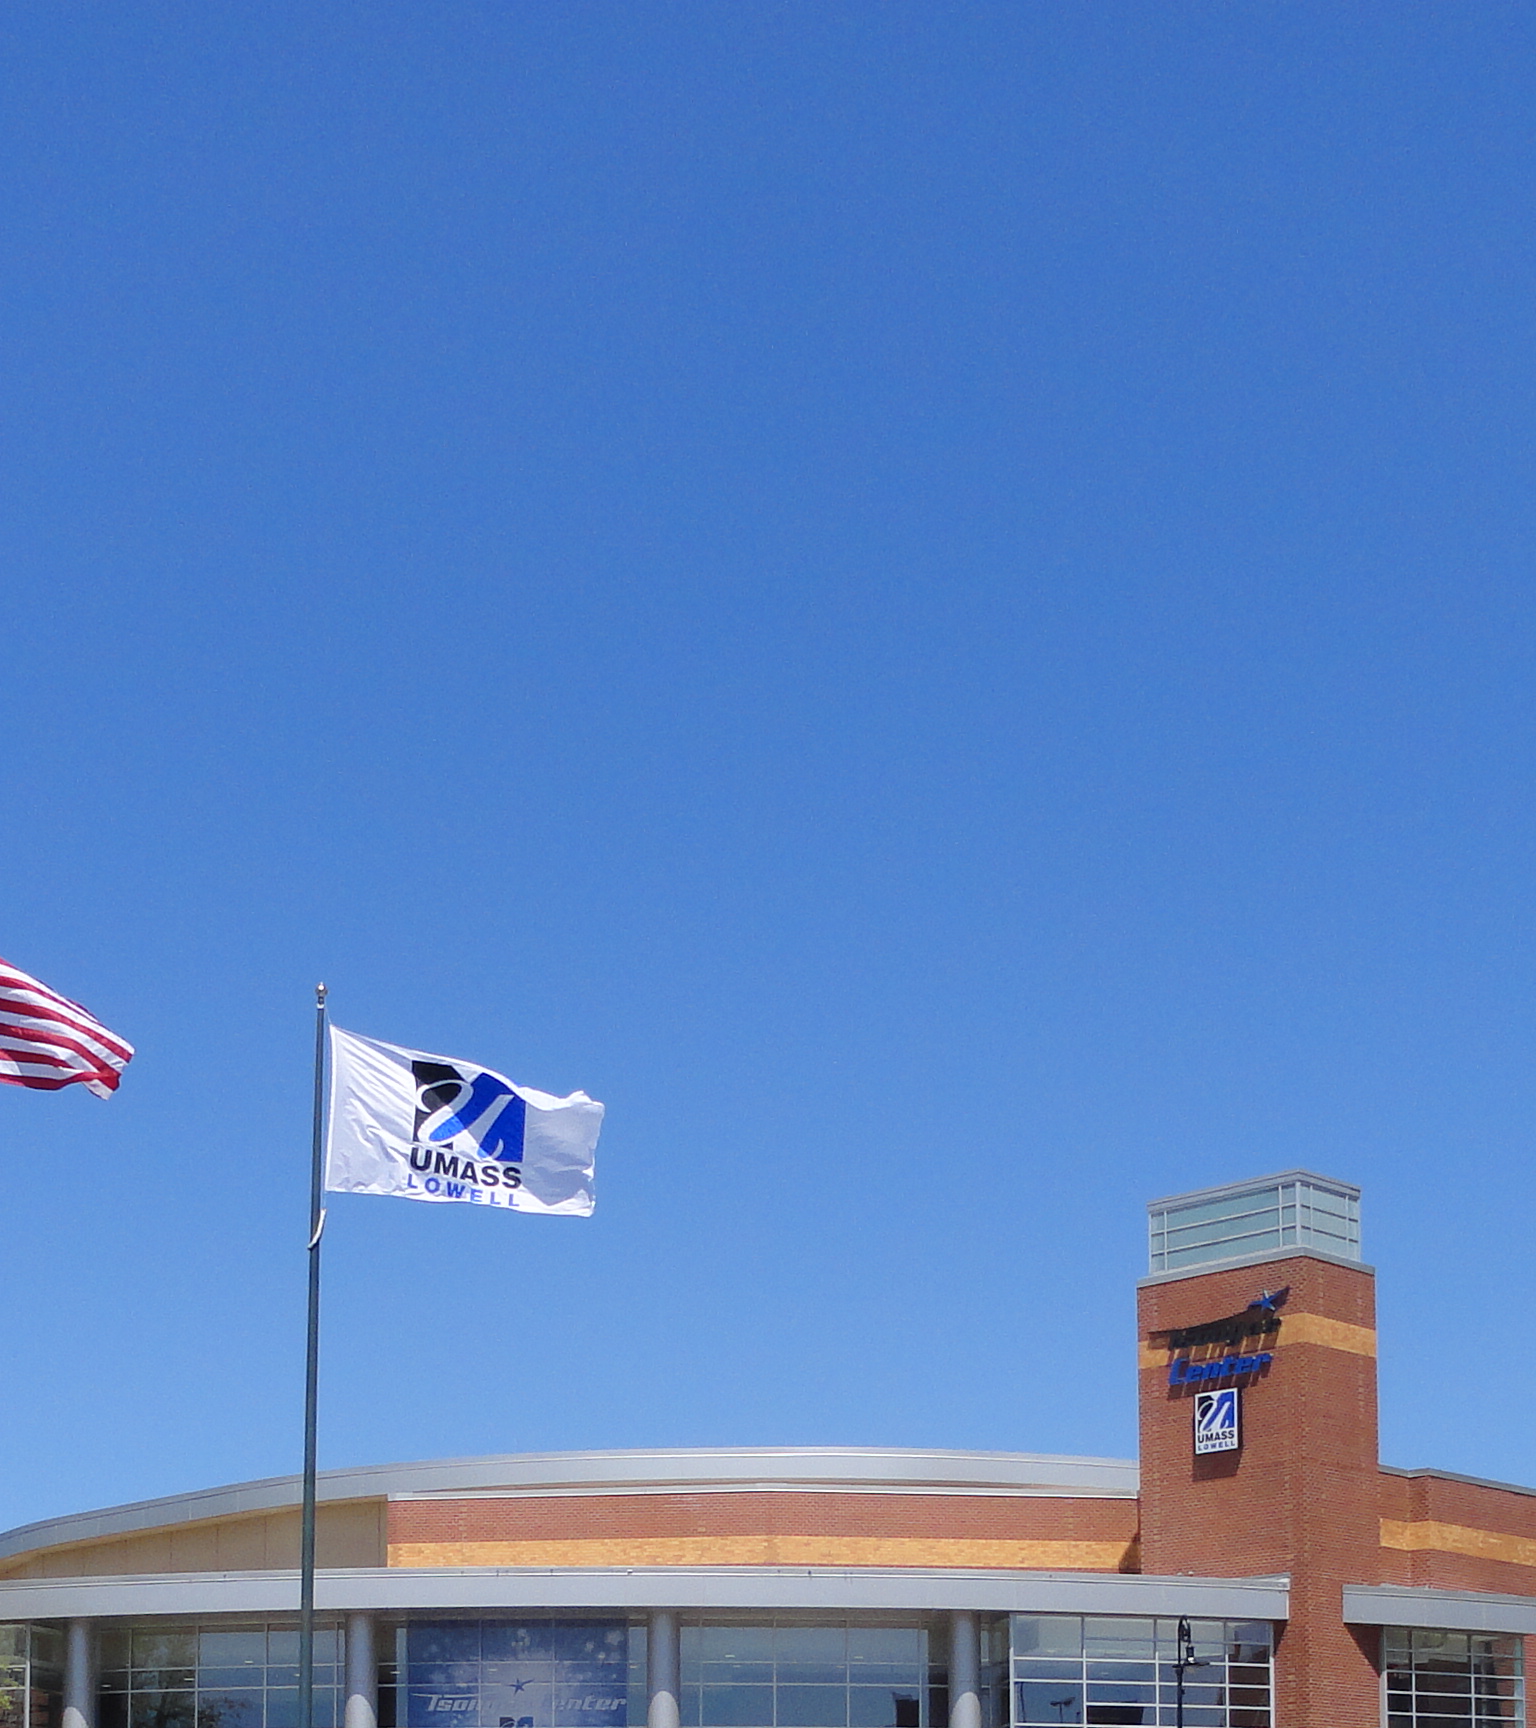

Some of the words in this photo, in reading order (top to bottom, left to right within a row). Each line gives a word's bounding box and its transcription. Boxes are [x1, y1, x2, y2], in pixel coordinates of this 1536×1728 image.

[411, 1146, 522, 1189] UMASS
[407, 1173, 520, 1207] LOWELL
[1168, 1353, 1273, 1385] Center
[1197, 1429, 1235, 1443] UMASS
[1197, 1440, 1235, 1451] LOWELL
